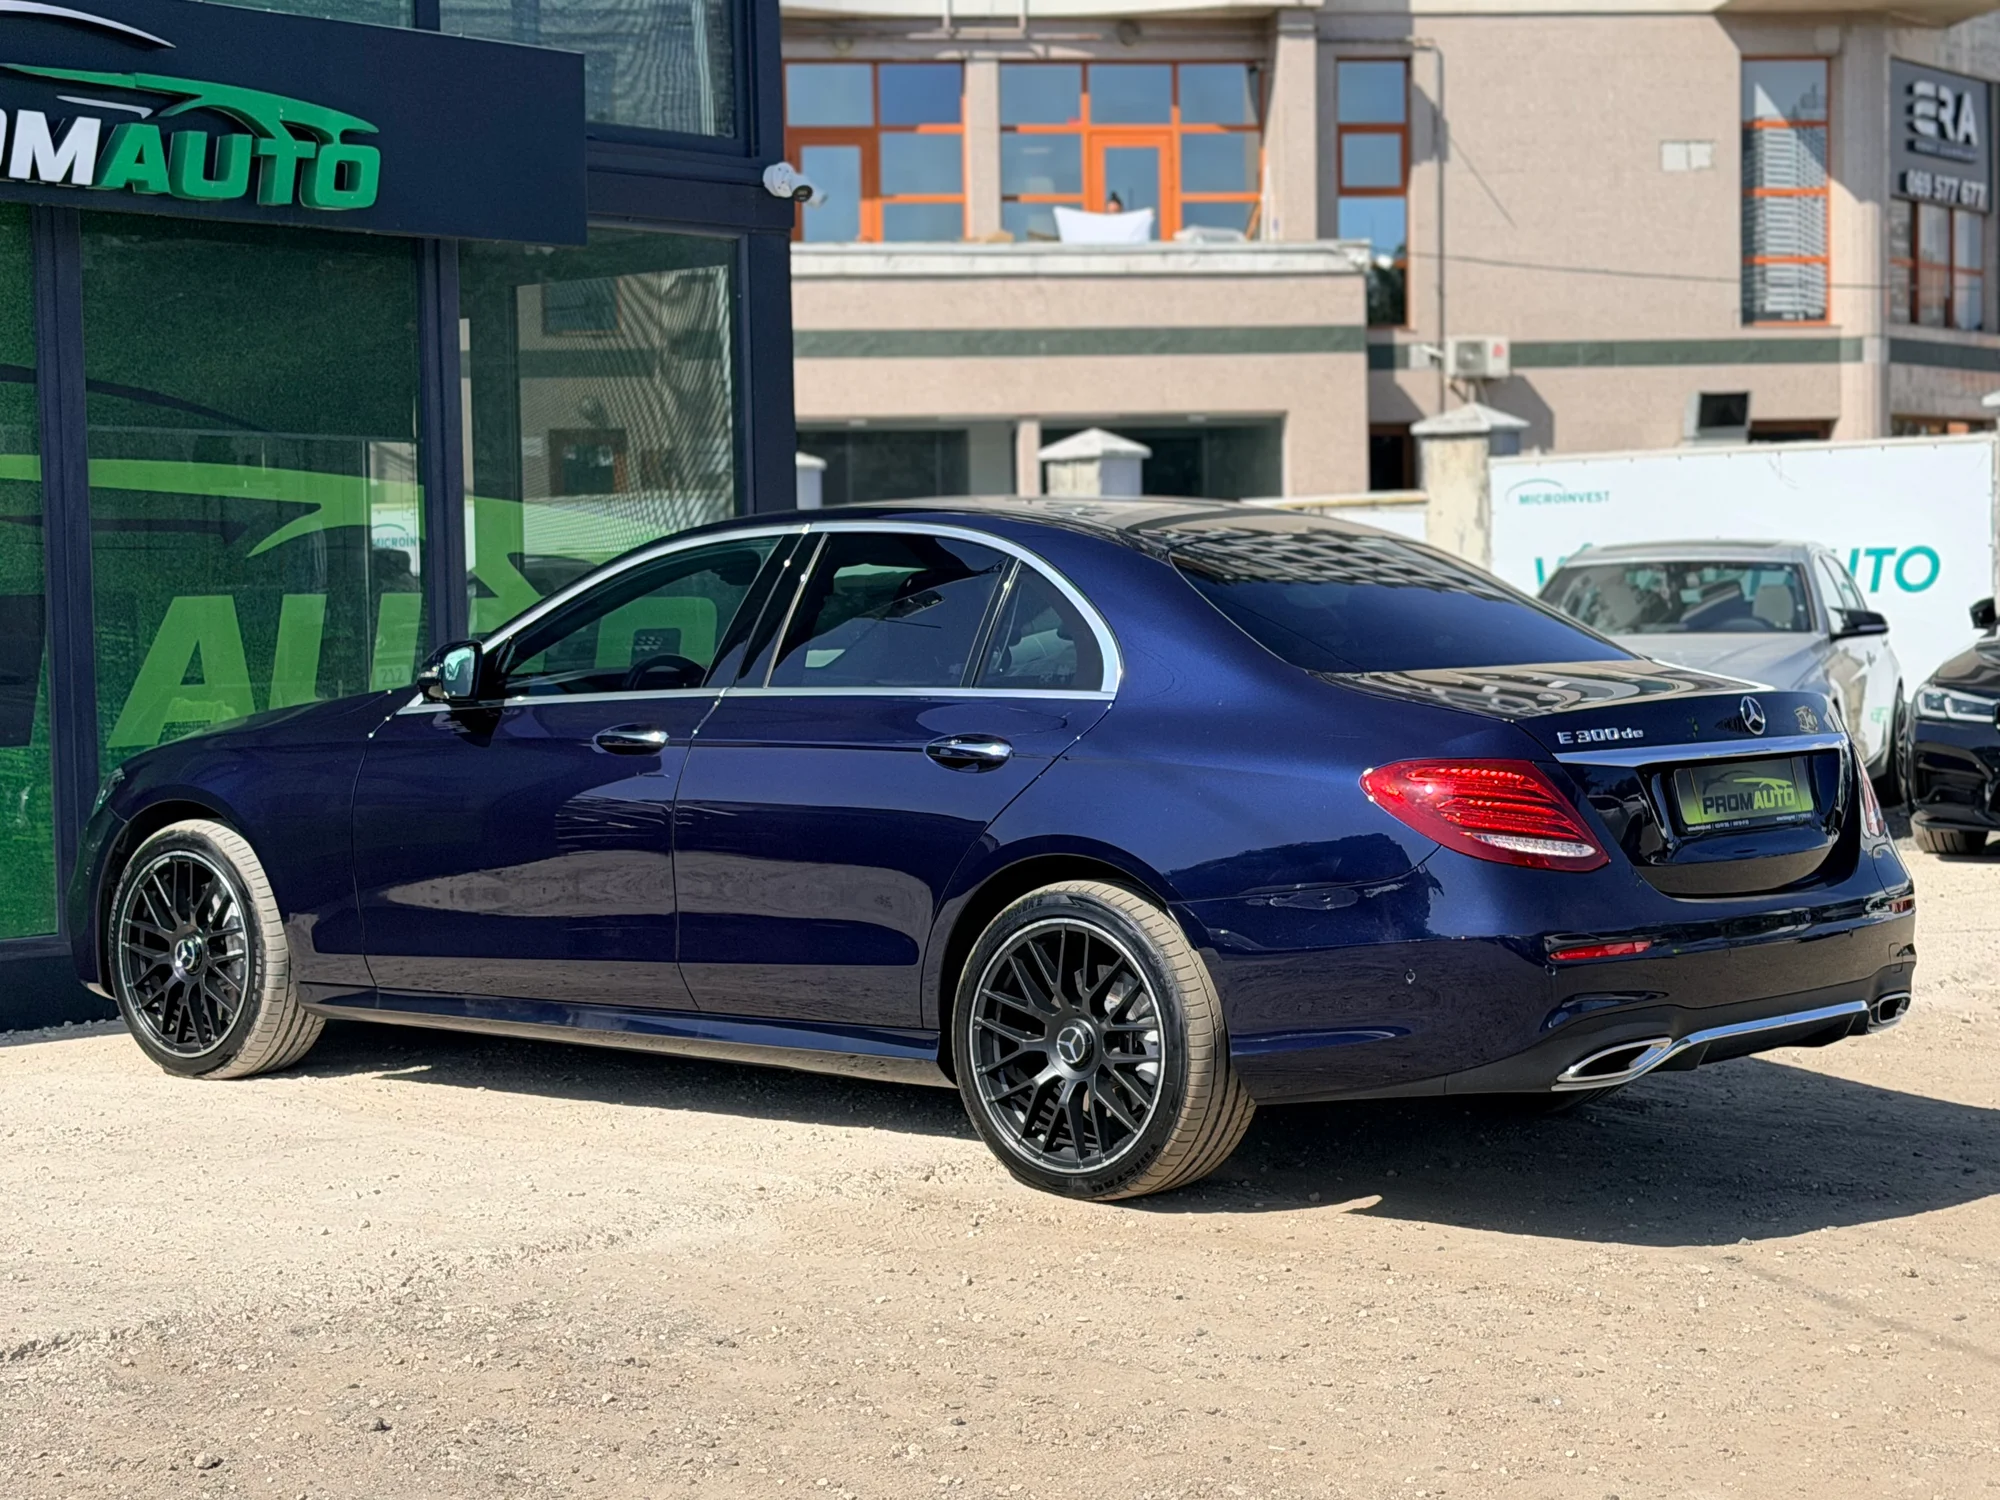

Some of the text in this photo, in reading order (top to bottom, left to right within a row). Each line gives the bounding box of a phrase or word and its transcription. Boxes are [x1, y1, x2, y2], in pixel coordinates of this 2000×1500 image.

[1911, 80, 1979, 147] ERA
[0, 108, 380, 210] MAUTO
[1518, 490, 1610, 505] MICROINVEST
[1556, 731, 1574, 745] E
[1702, 787, 1796, 815] PROMAUTO
